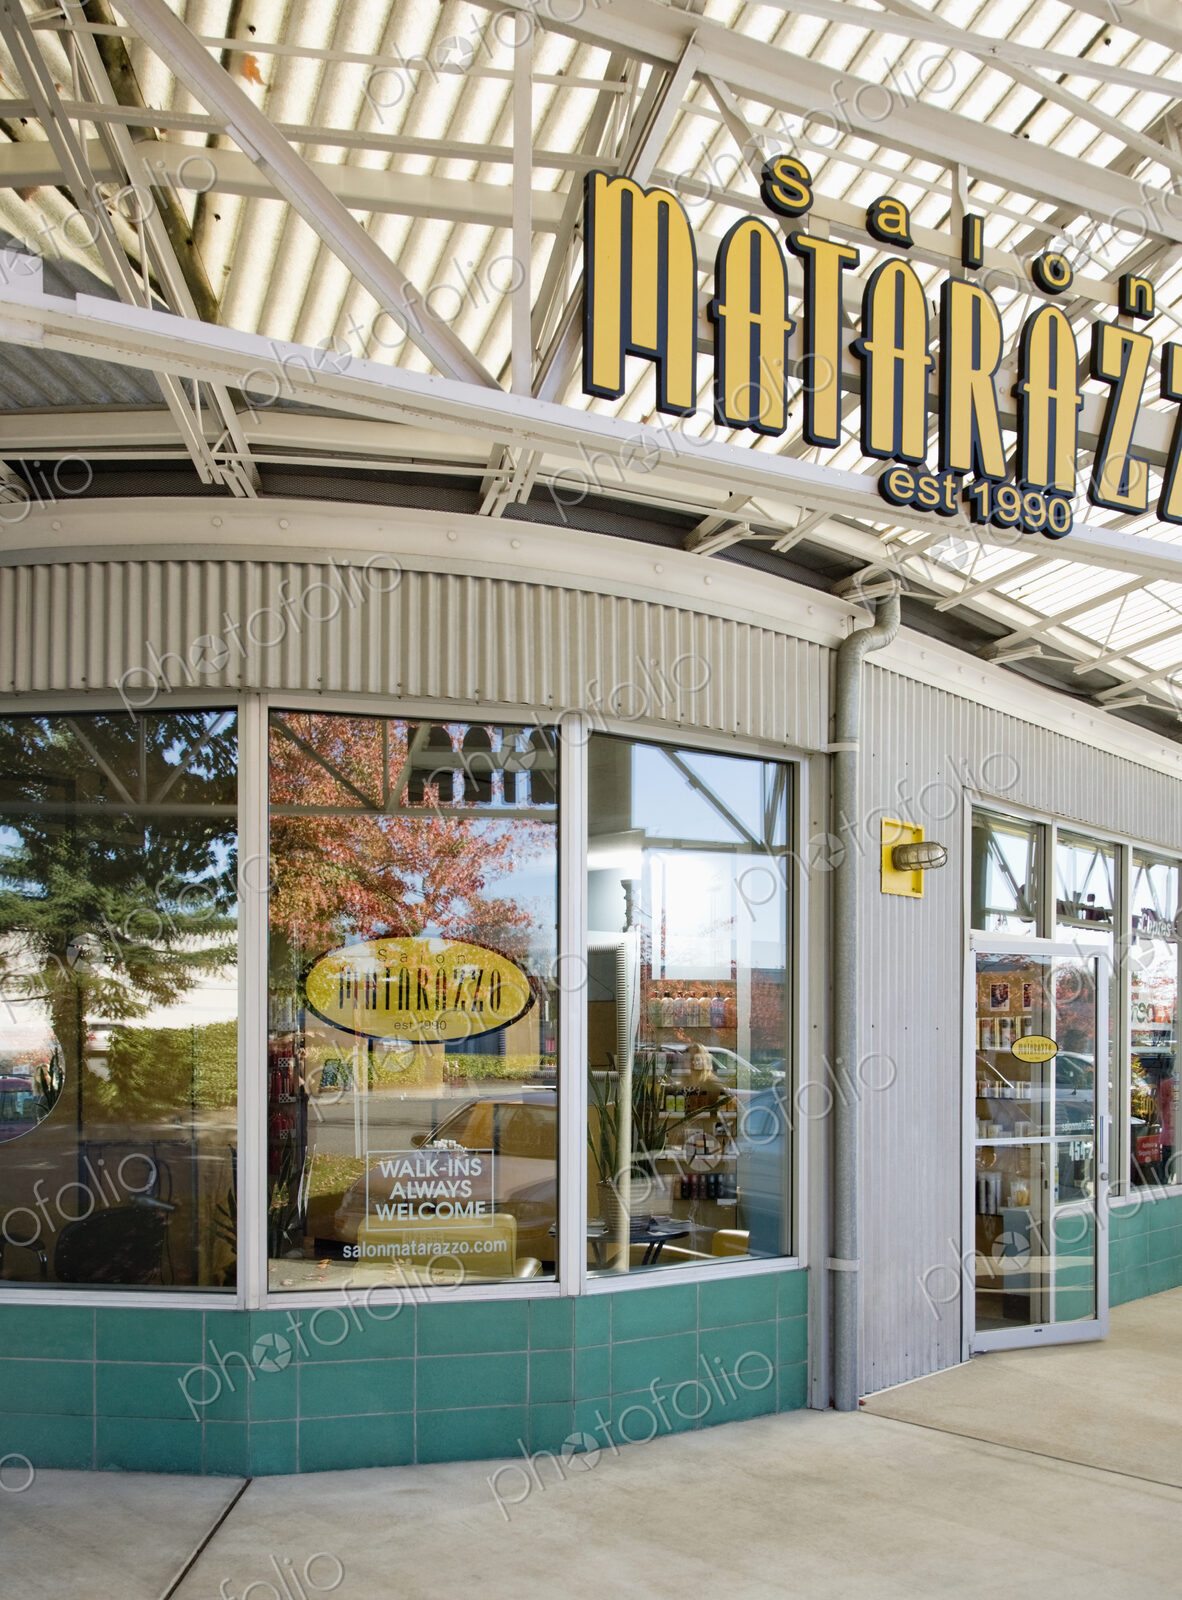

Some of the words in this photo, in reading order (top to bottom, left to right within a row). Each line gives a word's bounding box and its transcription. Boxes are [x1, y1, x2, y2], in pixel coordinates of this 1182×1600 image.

[879, 467, 958, 515] est
[963, 480, 1073, 539] 1990
[338, 966, 502, 1013] MATARAZZO
[379, 1158, 483, 1179] WALK-INS
[389, 1180, 473, 1200] ALWAYS
[375, 1200, 487, 1222] WELCOME
[342, 1238, 508, 1259] salonmatarazzo.com
